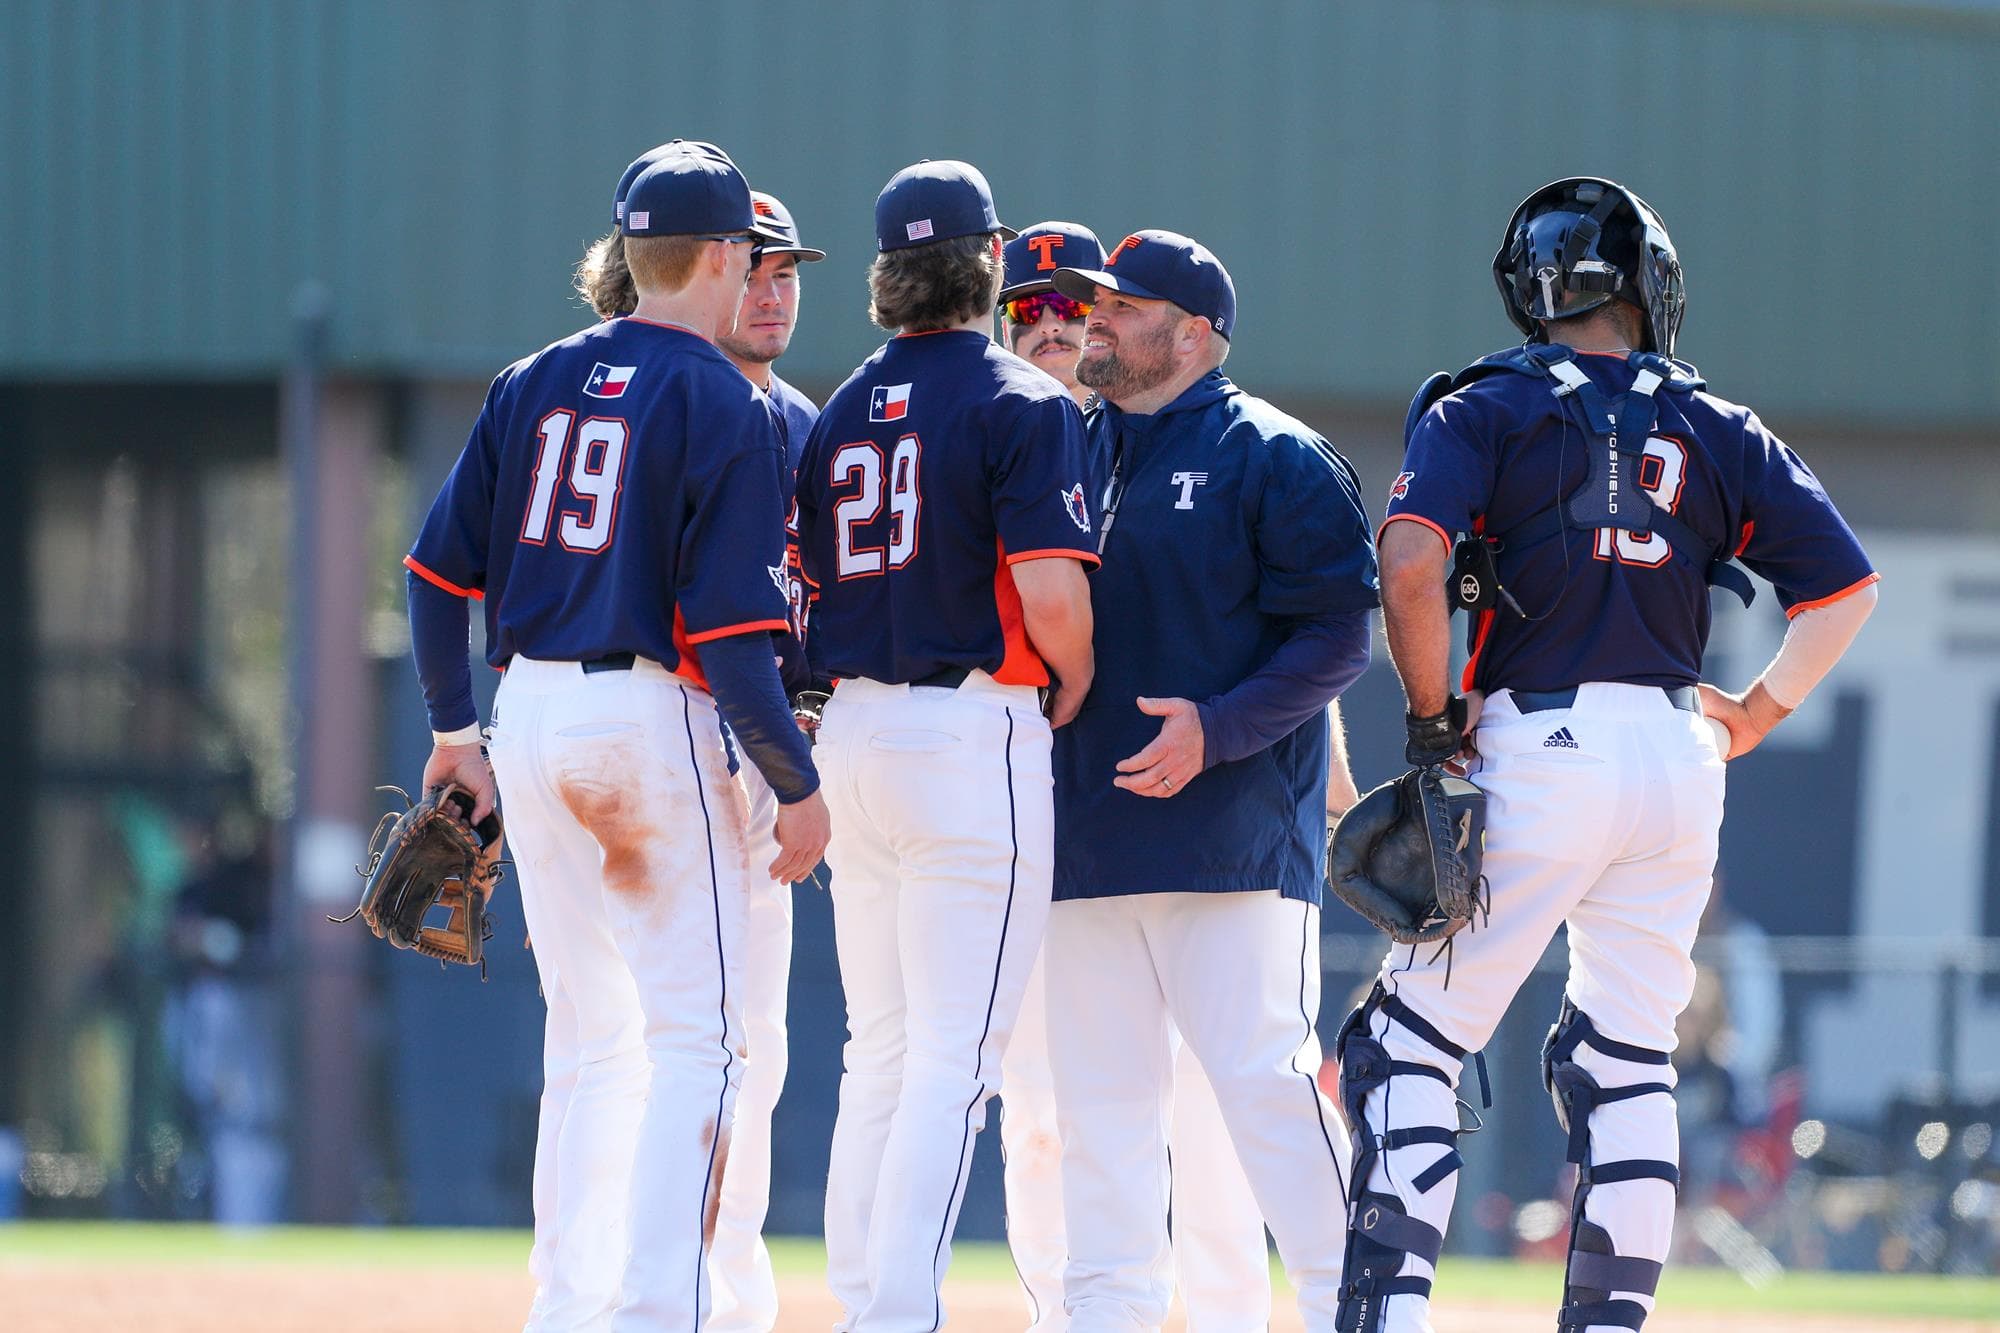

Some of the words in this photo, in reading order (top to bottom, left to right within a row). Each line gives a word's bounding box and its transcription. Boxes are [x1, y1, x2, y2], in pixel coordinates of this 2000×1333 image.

[1028, 234, 1064, 271] T
[519, 407, 630, 555] 19
[830, 432, 922, 583] 29
[1170, 471, 1209, 509] T
[1593, 434, 1688, 568] 8
[1607, 413, 1618, 514] EOSHIELD
[1543, 738, 1579, 749] adidas
